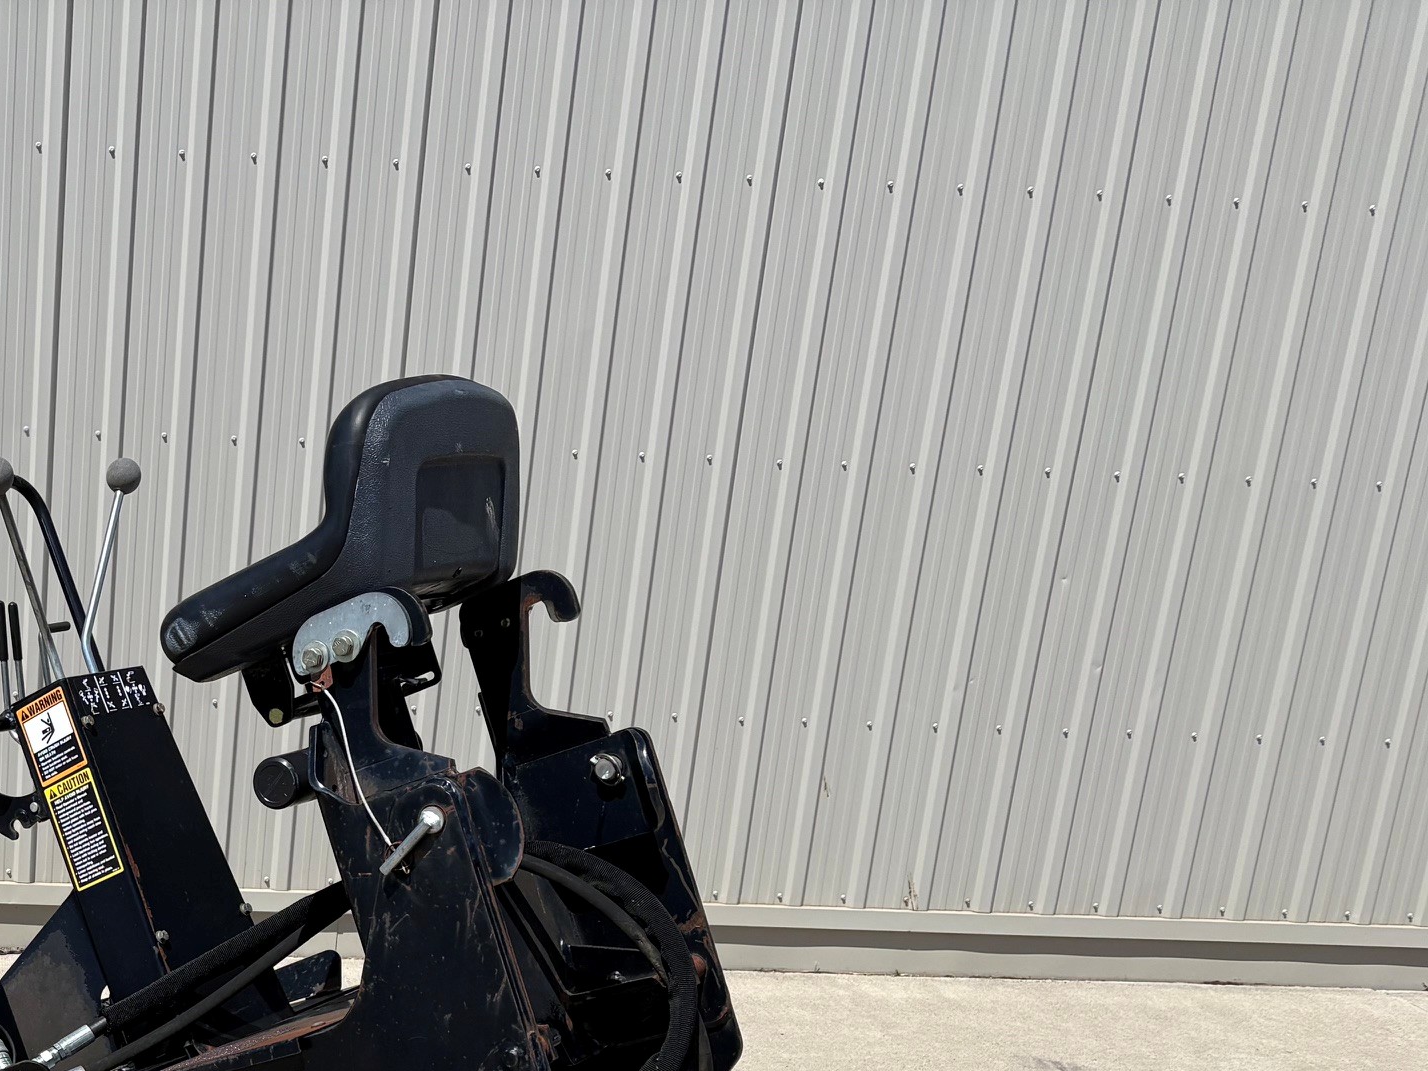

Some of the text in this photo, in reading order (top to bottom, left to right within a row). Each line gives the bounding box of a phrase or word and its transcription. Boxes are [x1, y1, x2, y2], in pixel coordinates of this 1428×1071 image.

[27, 689, 63, 716] WARNING
[56, 770, 90, 795] CAUTION
[64, 791, 76, 800] AVOID
